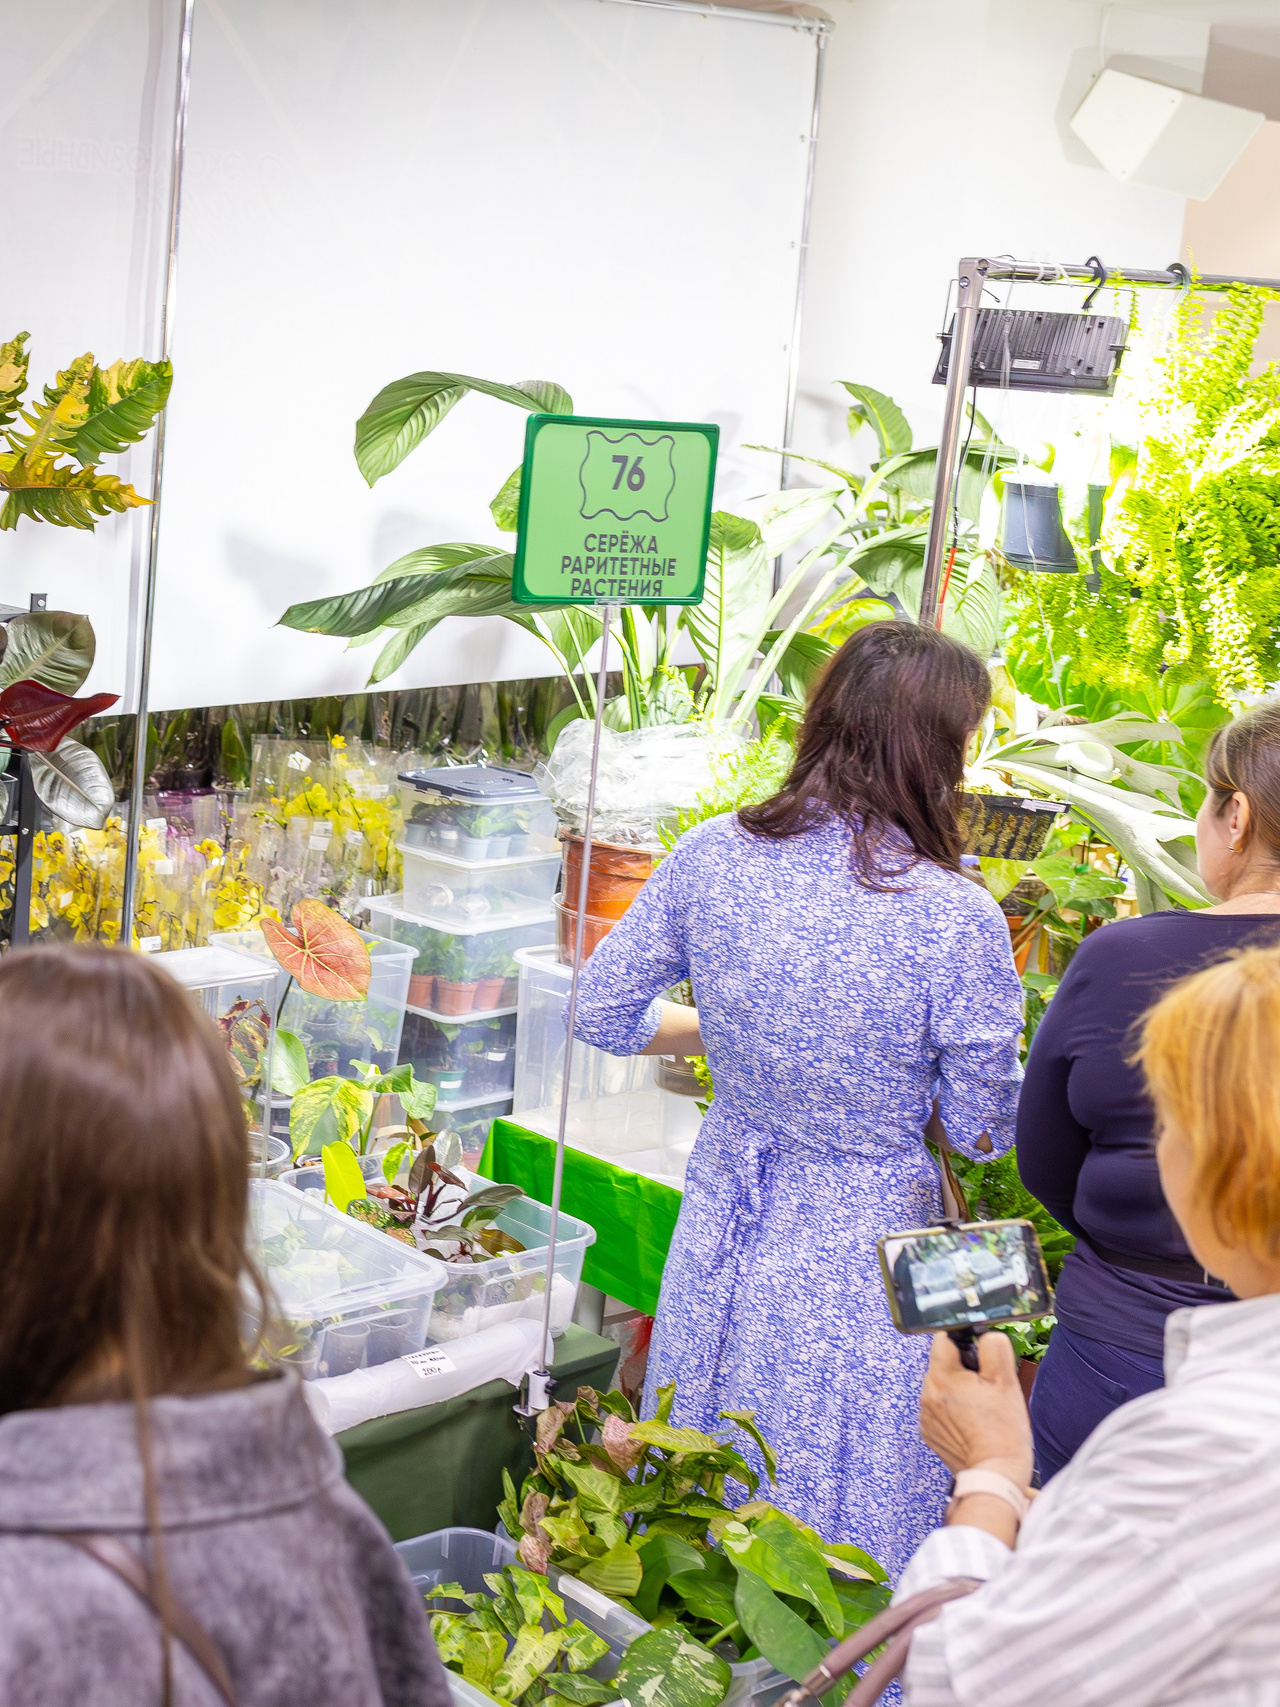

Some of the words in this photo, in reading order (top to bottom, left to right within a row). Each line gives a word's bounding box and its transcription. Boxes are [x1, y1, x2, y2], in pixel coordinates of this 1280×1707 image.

[611, 454, 646, 492] 76
[583, 530, 659, 555] СЕРЁЖА
[560, 555, 678, 577] РАРИТЕТНЫЕ
[570, 578, 664, 597] РАСТЕНИЯ
